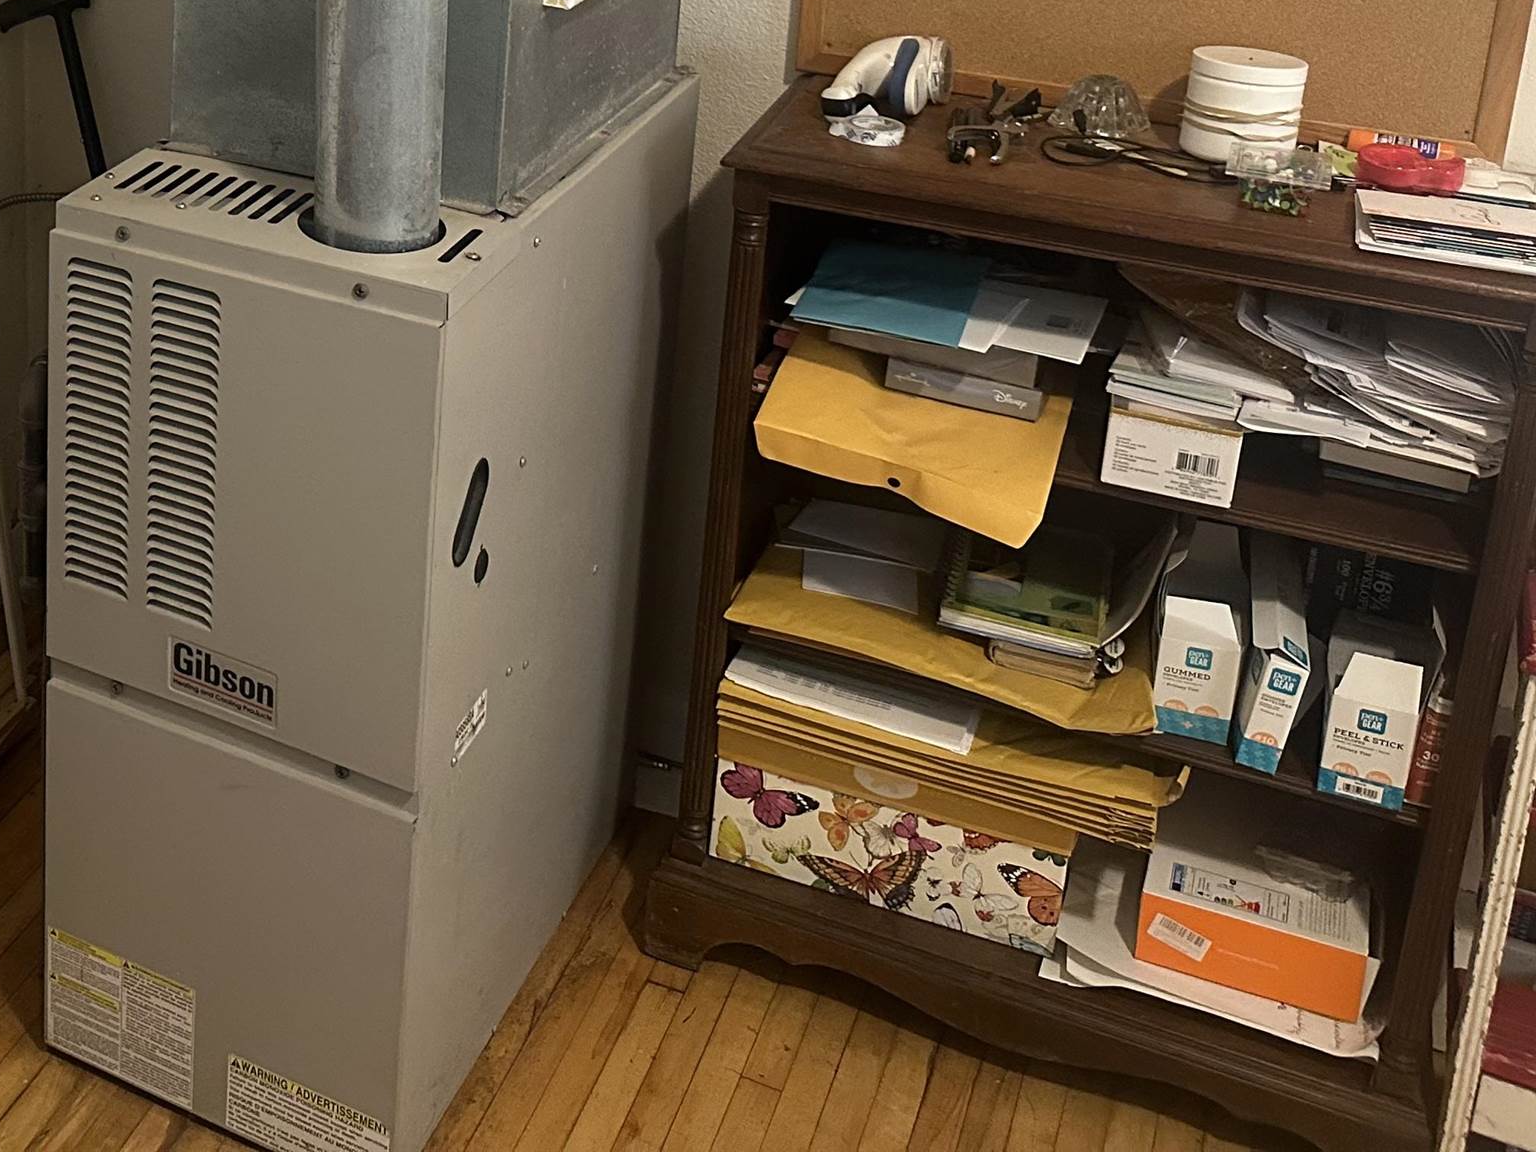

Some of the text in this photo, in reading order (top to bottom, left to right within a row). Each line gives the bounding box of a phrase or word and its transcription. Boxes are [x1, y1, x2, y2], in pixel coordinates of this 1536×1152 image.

[173, 642, 274, 709] Gibson
[1163, 665, 1211, 681] GUMMED
[1273, 678, 1295, 692] GEAR
[1362, 718, 1383, 731] GEAR
[1333, 727, 1361, 740] PEEL
[1363, 735, 1371, 743] &
[1372, 737, 1405, 751] STICK
[241, 1059, 289, 1091] WARNING
